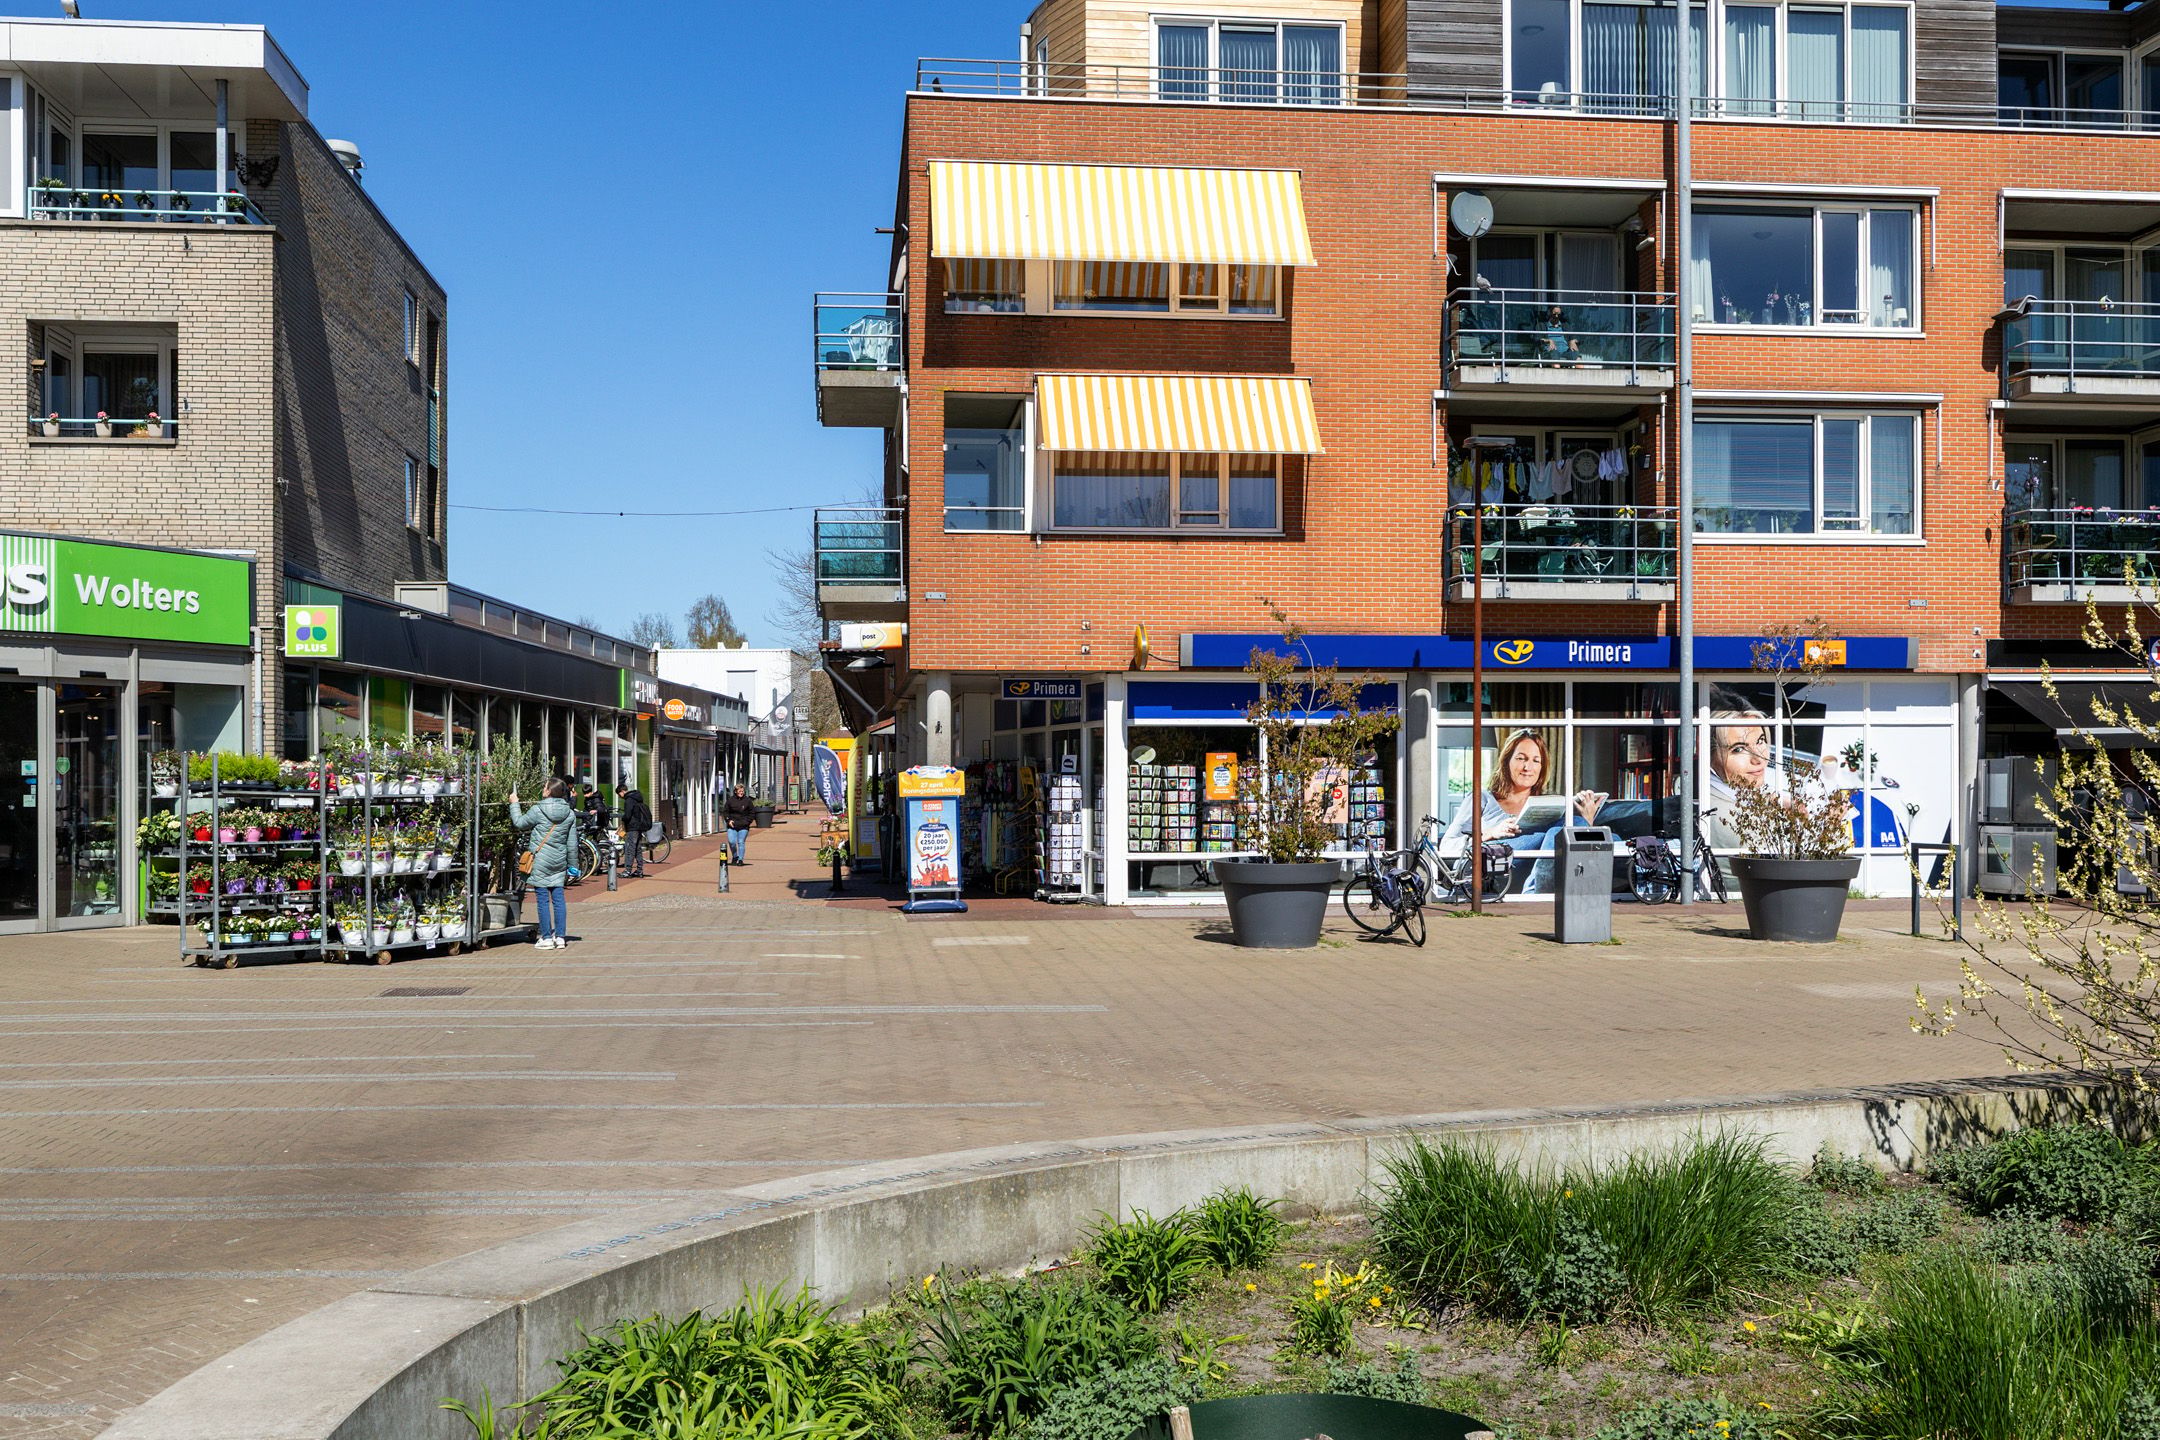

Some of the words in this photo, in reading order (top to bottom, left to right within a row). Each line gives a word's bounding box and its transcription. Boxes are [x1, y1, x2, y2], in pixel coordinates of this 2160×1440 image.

[0, 564, 48, 606] S
[73, 573, 200, 613] Wolters
[295, 643, 328, 653] PLUS
[1569, 641, 1631, 662] Primera
[1034, 682, 1075, 695] Primera
